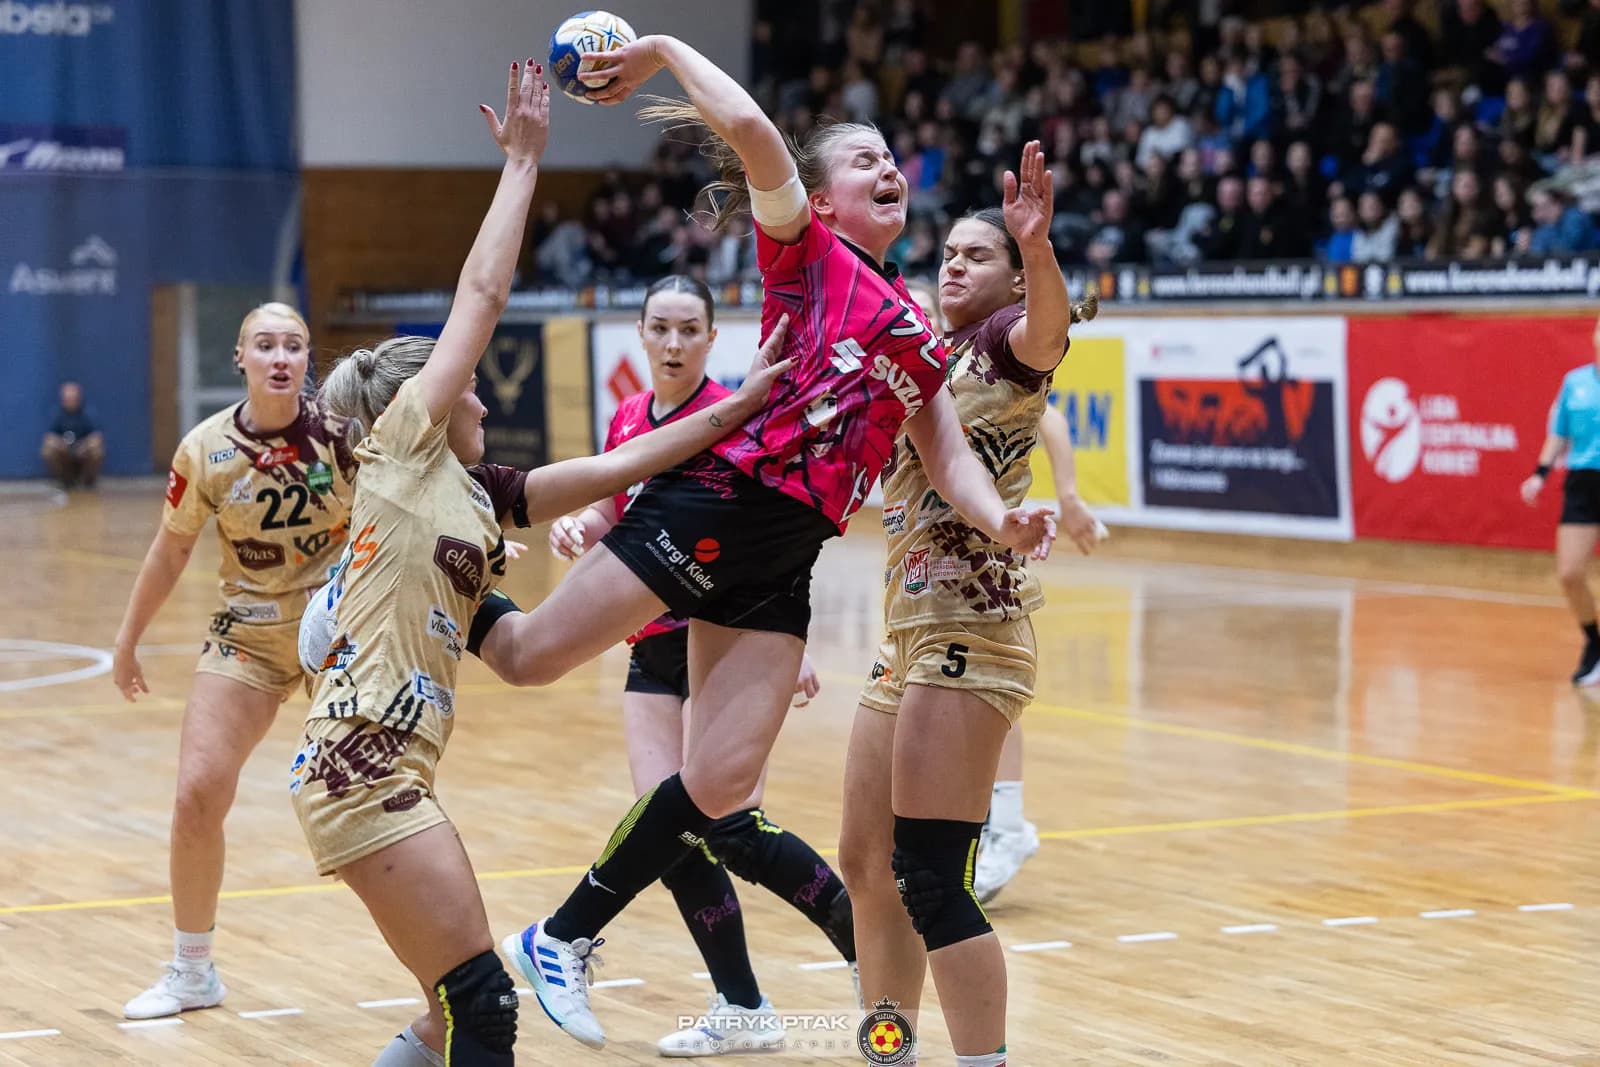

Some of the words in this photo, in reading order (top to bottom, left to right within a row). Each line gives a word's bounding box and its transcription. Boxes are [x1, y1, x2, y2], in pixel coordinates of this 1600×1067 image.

[577, 35, 595, 52] 17
[256, 484, 312, 531] 22
[656, 529, 689, 565] Targi
[941, 643, 968, 678] 5
